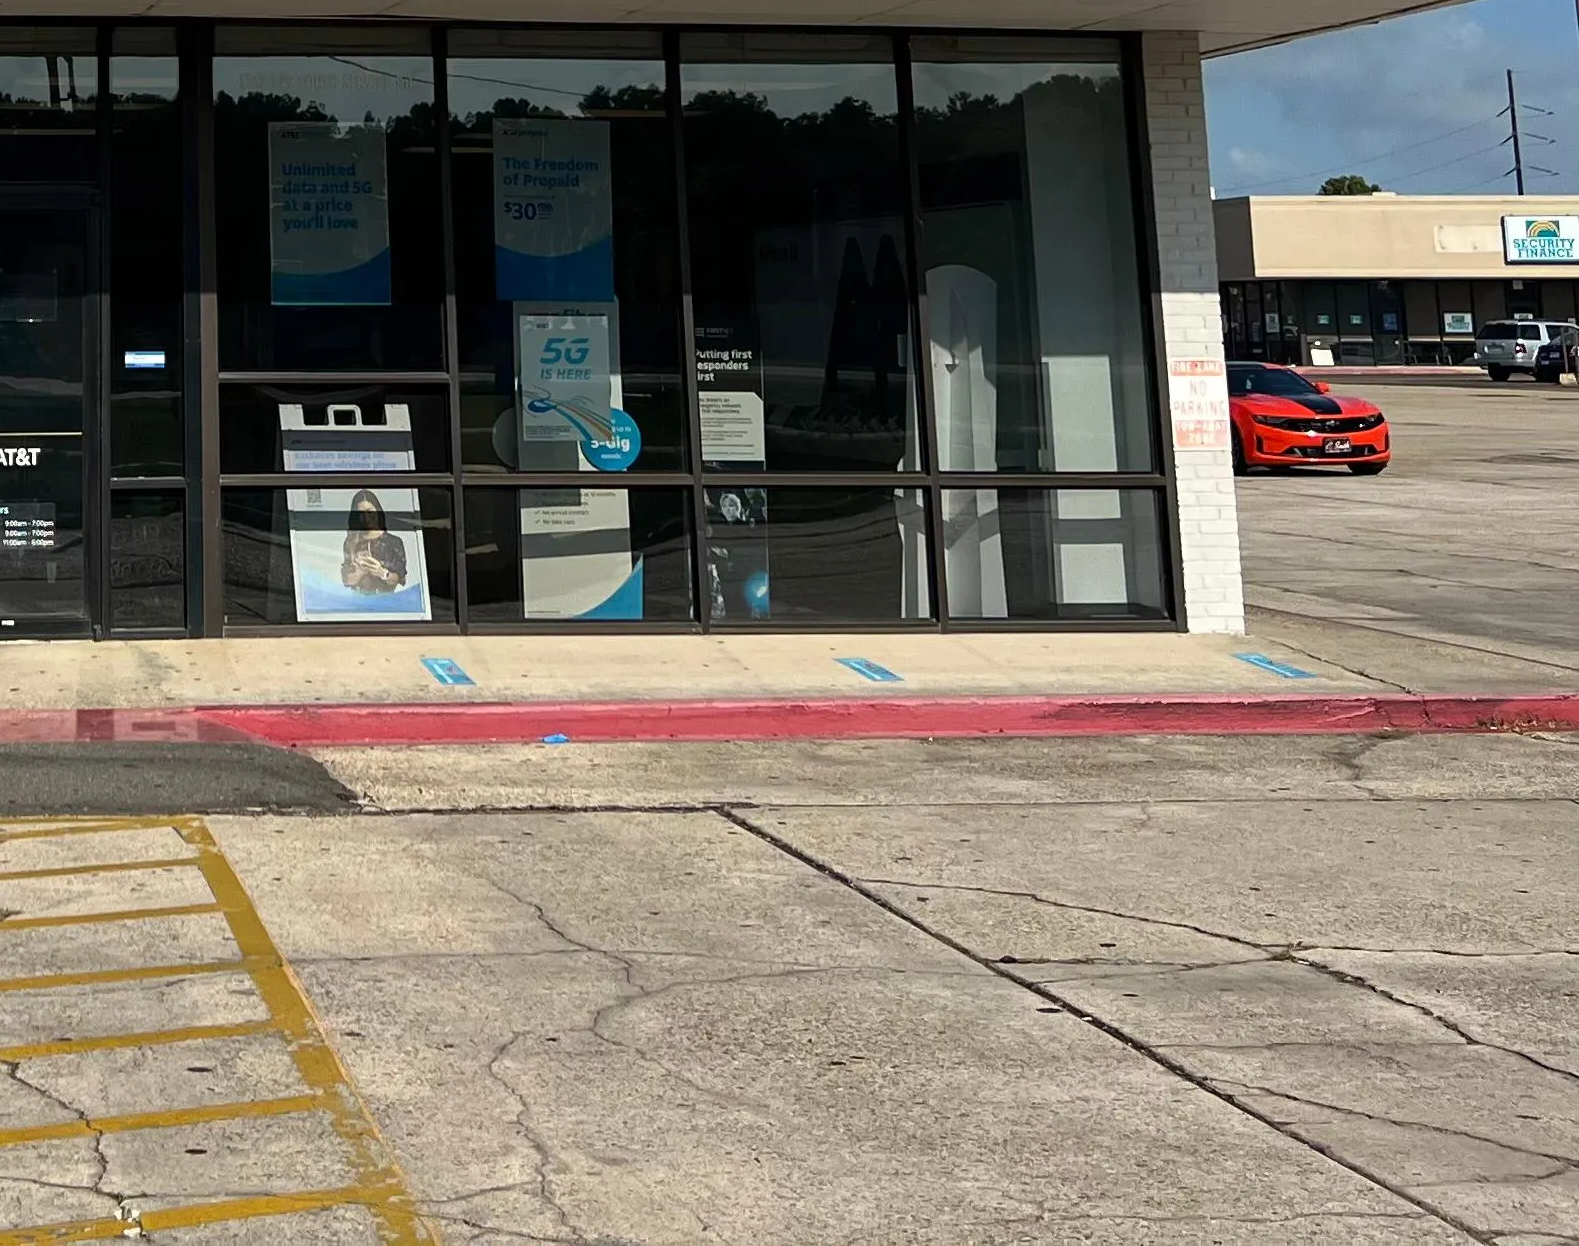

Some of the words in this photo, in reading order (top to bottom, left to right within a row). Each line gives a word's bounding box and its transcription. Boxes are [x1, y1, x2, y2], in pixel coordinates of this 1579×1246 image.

[282, 163, 356, 176] Unlimited
[503, 157, 530, 169] The
[534, 158, 598, 171] Freedom
[282, 180, 317, 194] data
[321, 181, 349, 194] and
[351, 181, 372, 194] 5G
[504, 174, 519, 186] of
[523, 175, 580, 189] Prepaid
[282, 200, 298, 211] at
[302, 201, 312, 211] a
[315, 197, 353, 215] price
[504, 201, 537, 221] $30
[283, 216, 324, 233] you'll
[328, 216, 359, 229] love
[1513, 238, 1575, 249] SECURITY
[1517, 248, 1573, 258] FINANCE
[539, 338, 590, 365] 5G
[731, 349, 753, 359] first
[697, 360, 749, 372] esponders
[540, 368, 552, 380] IS
[557, 369, 591, 380] HERE
[697, 371, 714, 382] irst
[1189, 380, 1207, 397] NO
